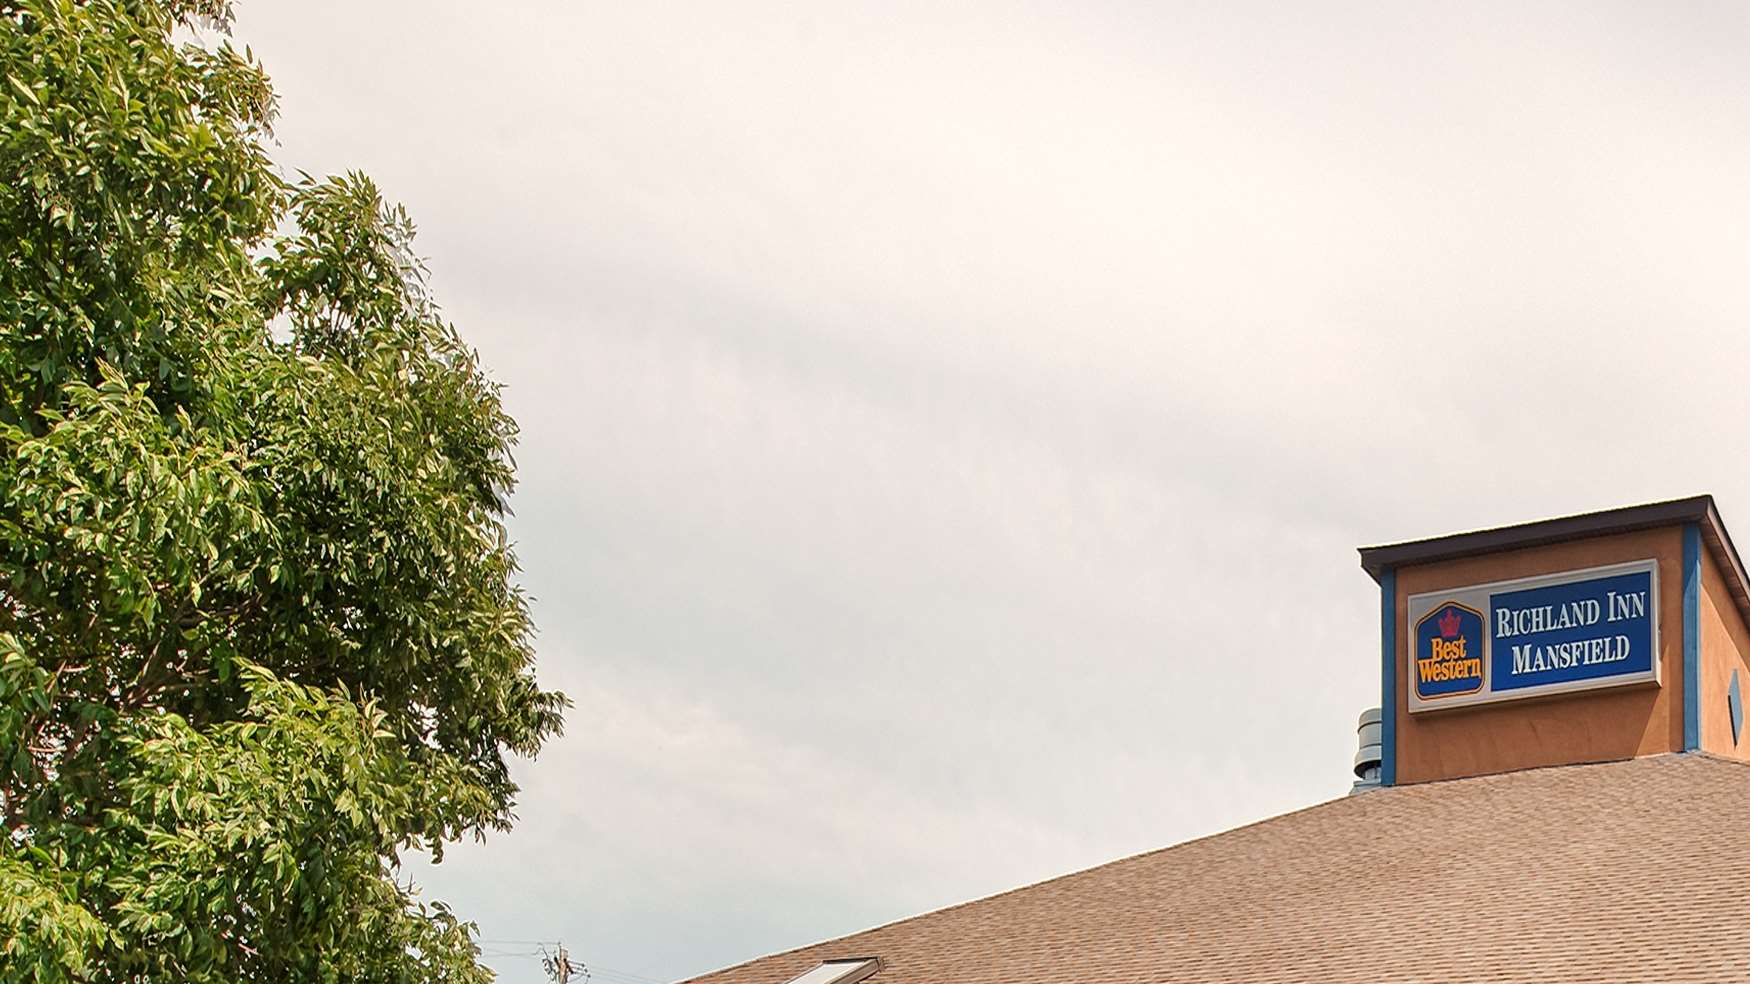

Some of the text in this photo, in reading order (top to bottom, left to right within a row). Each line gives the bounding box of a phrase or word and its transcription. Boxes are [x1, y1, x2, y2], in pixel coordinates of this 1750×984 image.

[1496, 591, 1645, 638] RICHLAND INN
[1431, 636, 1467, 660] Best
[1511, 635, 1630, 675] MANSFIELD
[1418, 657, 1481, 683] Western
